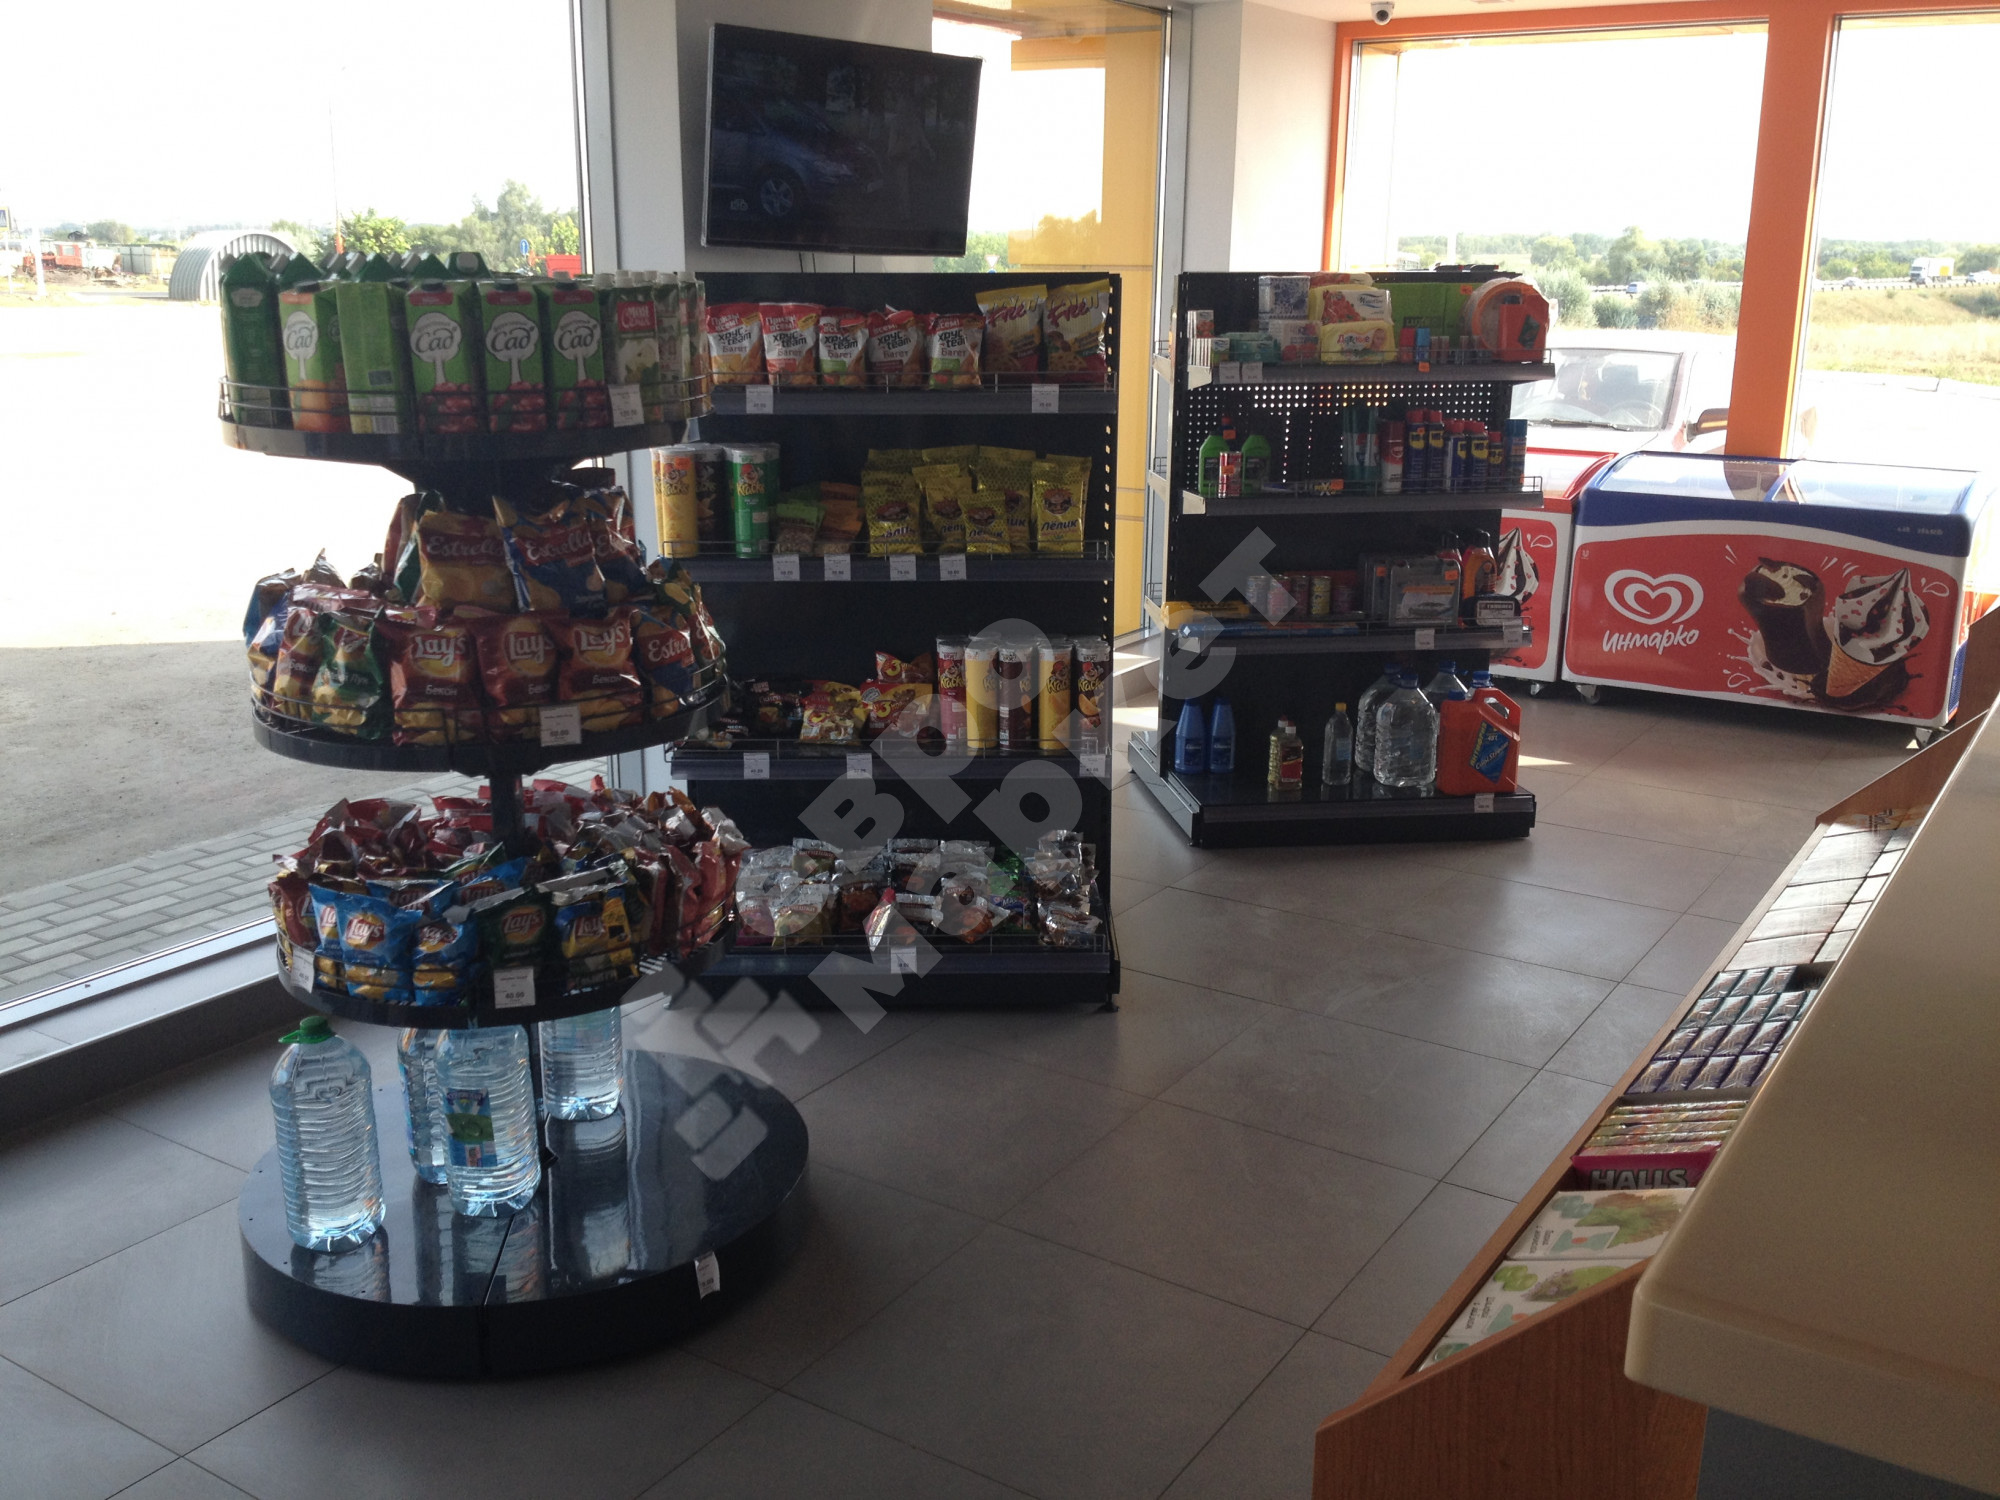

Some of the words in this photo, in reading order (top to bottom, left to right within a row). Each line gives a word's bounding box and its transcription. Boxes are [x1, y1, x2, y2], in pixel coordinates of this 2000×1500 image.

[415, 326, 458, 353] Сад
[491, 326, 536, 353] Сад
[558, 325, 598, 351] Сад
[1040, 519, 1079, 532] Лёлик
[425, 684, 458, 697] Бекон
[1590, 1168, 1689, 1190] HALLS
